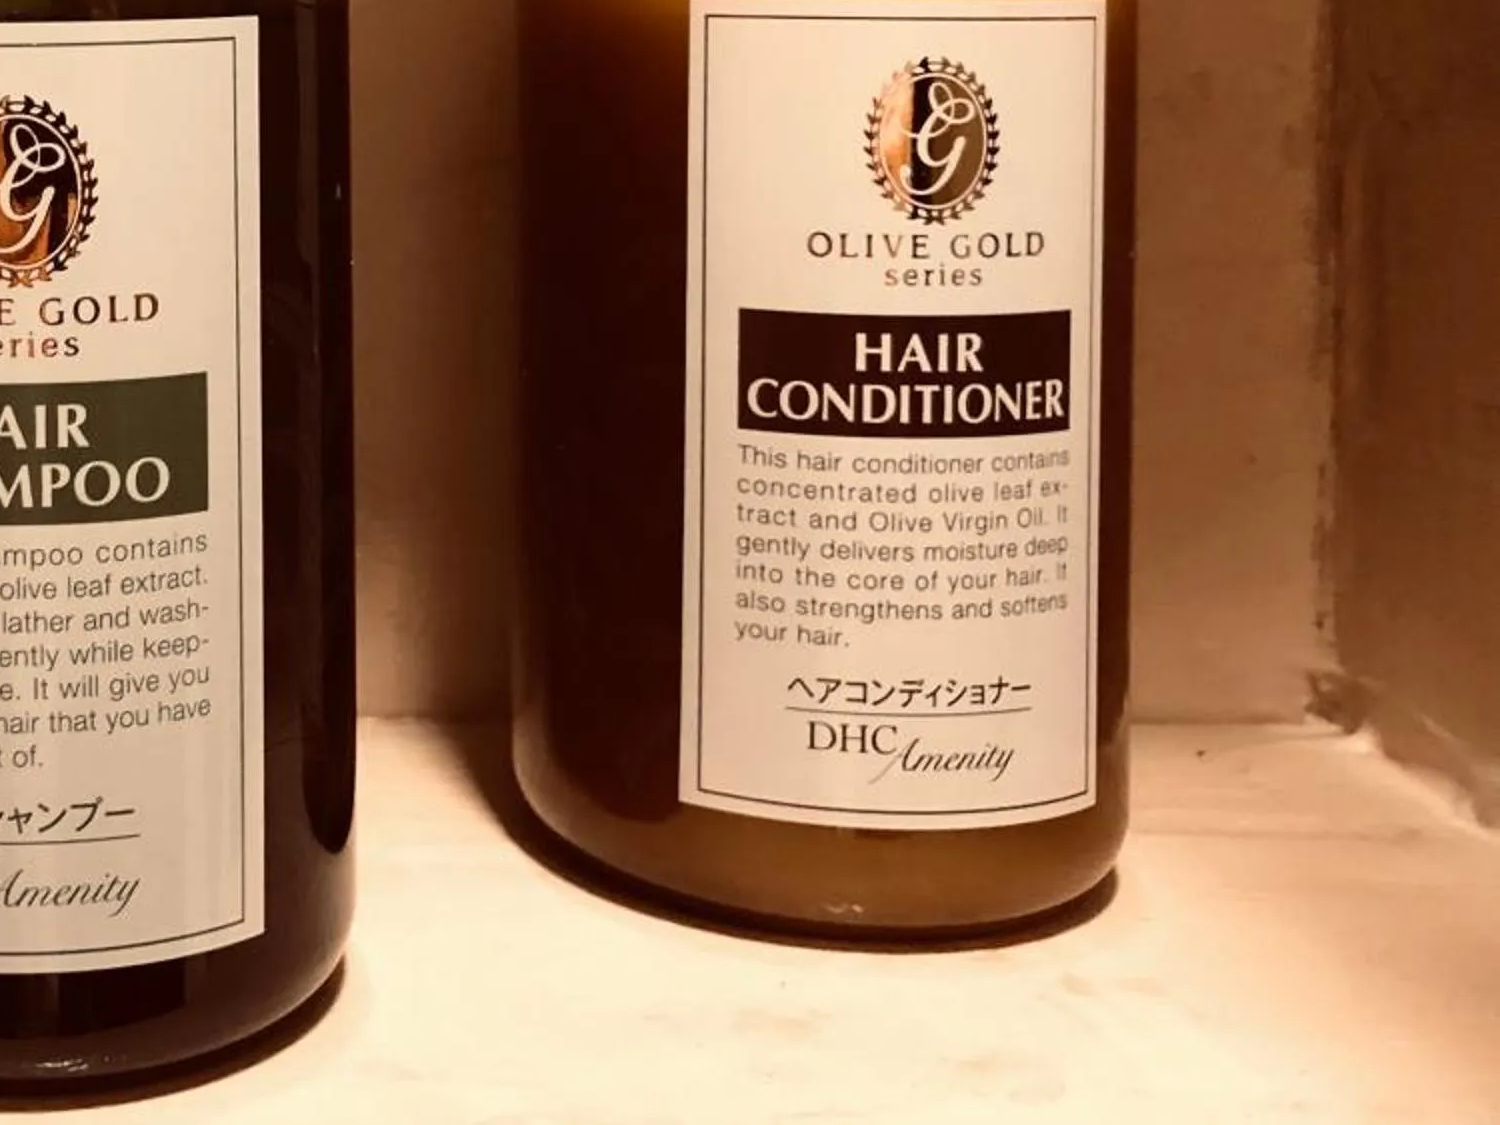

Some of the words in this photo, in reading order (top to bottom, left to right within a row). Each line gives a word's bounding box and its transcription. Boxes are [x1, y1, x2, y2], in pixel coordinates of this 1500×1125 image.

[807, 231, 929, 259] OLIVE
[950, 231, 1045, 258] GOLD
[884, 263, 983, 287] series
[39, 292, 160, 326] GOLD
[855, 332, 984, 372] HAIR
[747, 377, 1065, 425] CONDITIONER
[738, 444, 787, 468] This
[797, 448, 841, 472] hair
[852, 449, 982, 475] conditioner
[991, 448, 1070, 472] contains
[737, 475, 916, 503] concentrated
[929, 480, 984, 503] olive
[994, 478, 1032, 501] leaf
[1040, 479, 1069, 496] ex-
[737, 503, 796, 527] tract
[809, 508, 857, 531] and
[868, 511, 932, 533] Olive
[942, 511, 1008, 535] Virgin
[1016, 507, 1049, 527] Oil.
[1057, 505, 1067, 524] It
[95, 531, 208, 563] contains
[736, 532, 810, 560] gently
[819, 538, 914, 562] delivers
[924, 539, 1018, 562] moisture
[1024, 534, 1068, 557] deep
[0, 575, 57, 601] olive
[67, 574, 111, 598] leaf
[121, 565, 208, 594] extract.
[735, 562, 783, 585] into
[795, 566, 835, 588] the
[848, 572, 904, 590] core
[915, 569, 939, 591] of
[947, 570, 996, 595] your
[1006, 565, 1047, 586] hair.
[1056, 563, 1067, 581] It
[3, 608, 72, 634] lather
[83, 605, 130, 631] and
[139, 598, 209, 626] wash-
[735, 590, 786, 613] also
[795, 595, 942, 623] strengthens
[952, 594, 993, 618] and
[1000, 591, 1068, 617] softens
[70, 638, 133, 665] while
[143, 632, 209, 661] keep-
[734, 620, 788, 642] your
[797, 623, 849, 647] hair.
[34, 676, 49, 699] It
[59, 674, 100, 699] will
[109, 669, 159, 699] give
[168, 665, 210, 692] you
[787, 674, 1031, 707] ヘアコンディショナー
[49, 707, 97, 733] that
[106, 703, 148, 733] you
[158, 696, 211, 726] have
[12, 742, 44, 769] of.
[807, 720, 897, 756] DHC
[868, 738, 1016, 785] Amenity
